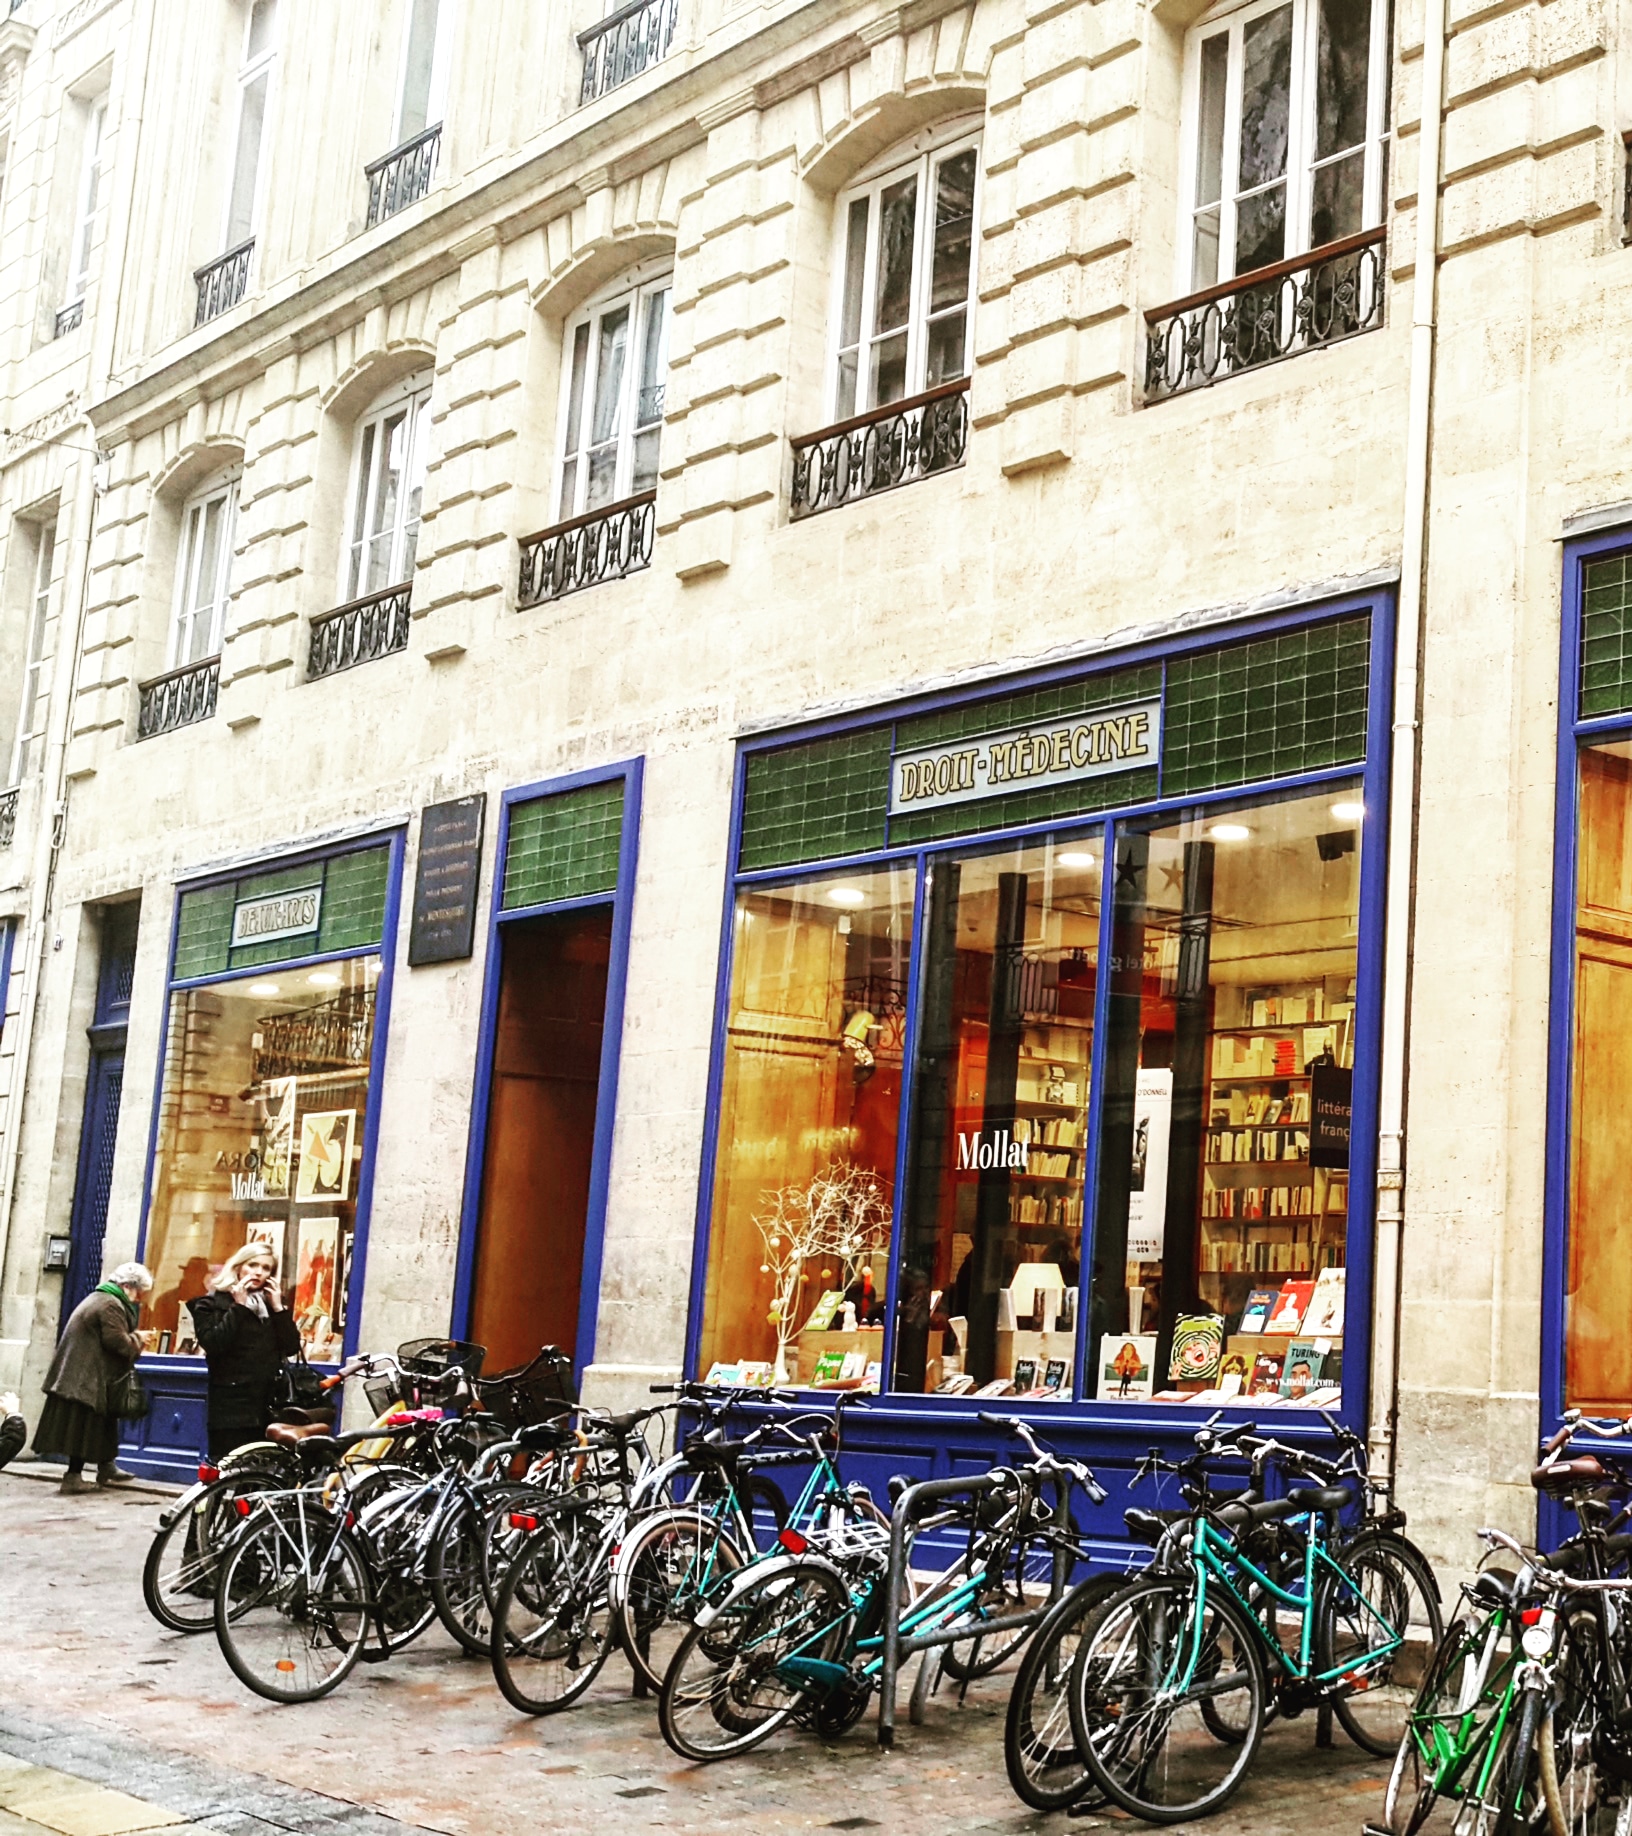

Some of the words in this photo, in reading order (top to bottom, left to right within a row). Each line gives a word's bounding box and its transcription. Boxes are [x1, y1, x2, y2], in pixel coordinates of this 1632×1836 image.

[900, 712, 1149, 802] DROIT-MÉDECINE
[237, 893, 316, 938] BEAUX-ARTS
[955, 1129, 1031, 1171] Mollat
